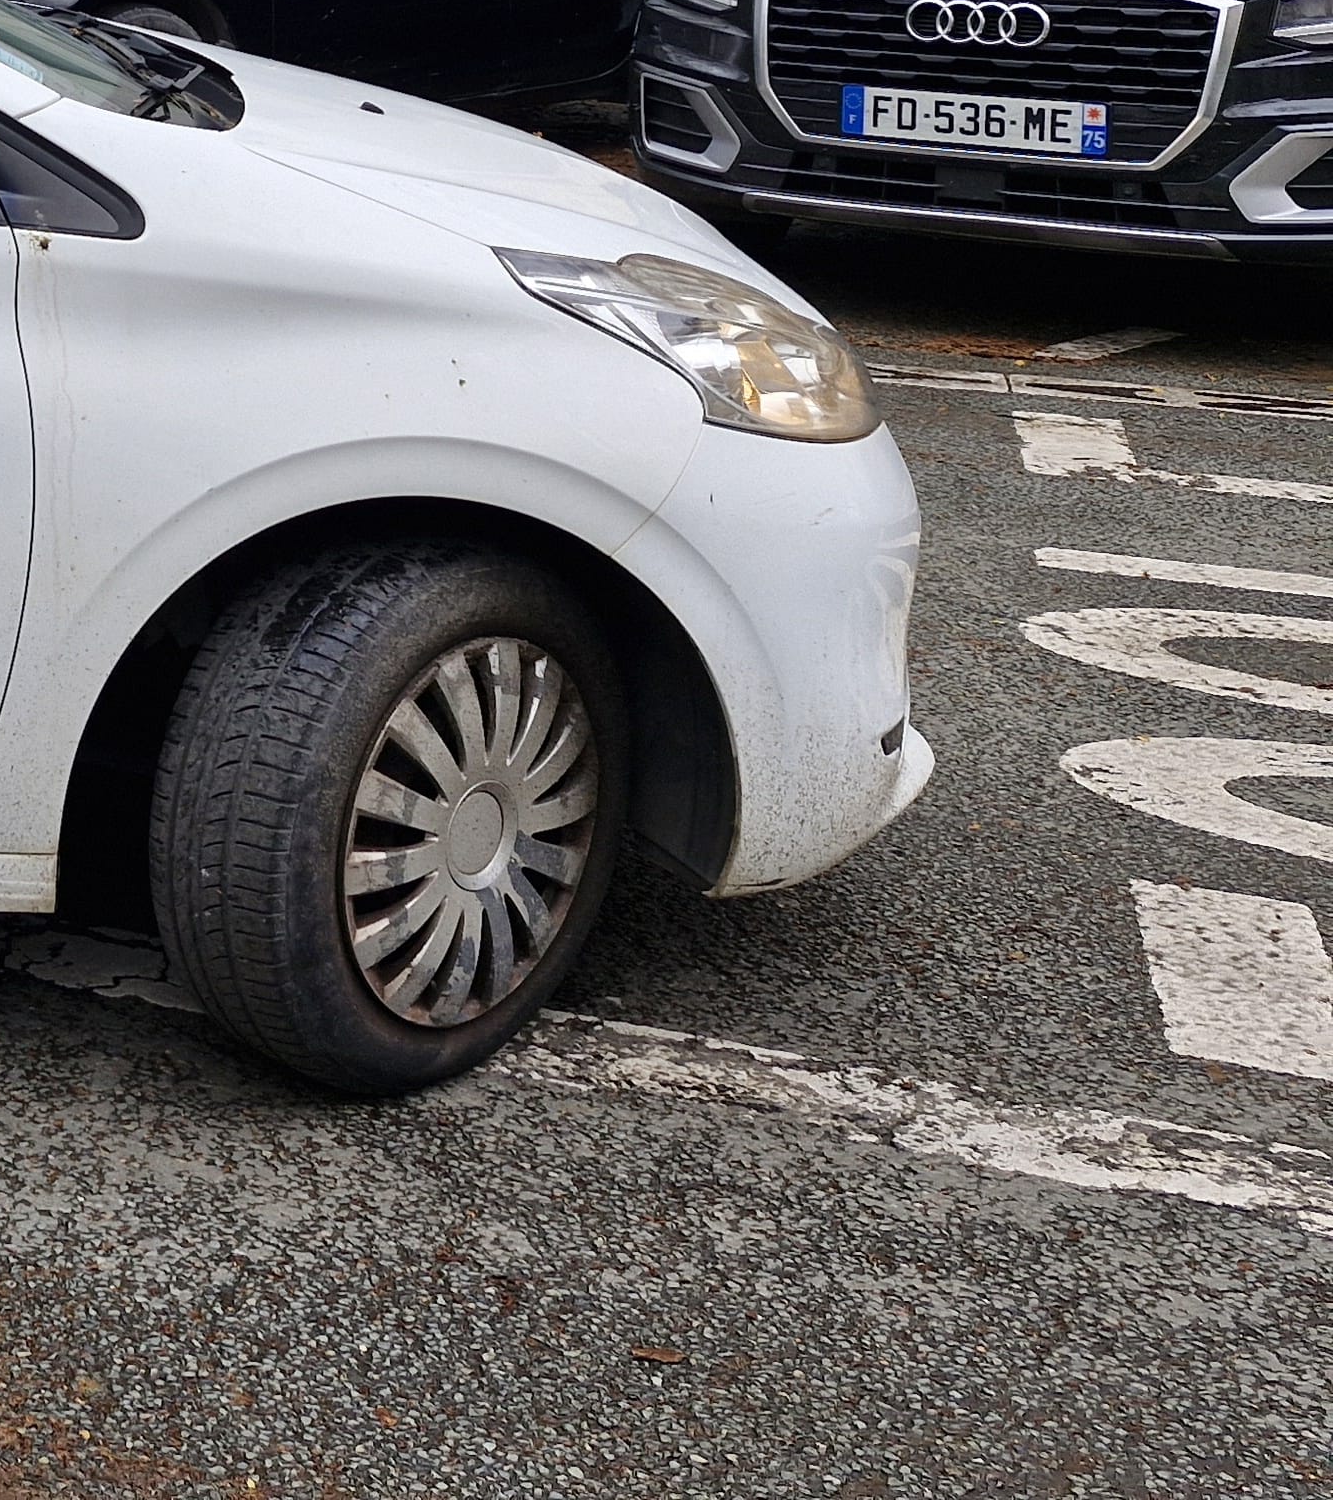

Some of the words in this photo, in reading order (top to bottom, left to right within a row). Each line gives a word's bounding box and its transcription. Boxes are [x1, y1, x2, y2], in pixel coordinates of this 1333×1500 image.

[848, 114, 857, 126] F
[872, 95, 1072, 143] FD-536-ME
[1084, 130, 1106, 149] 75
